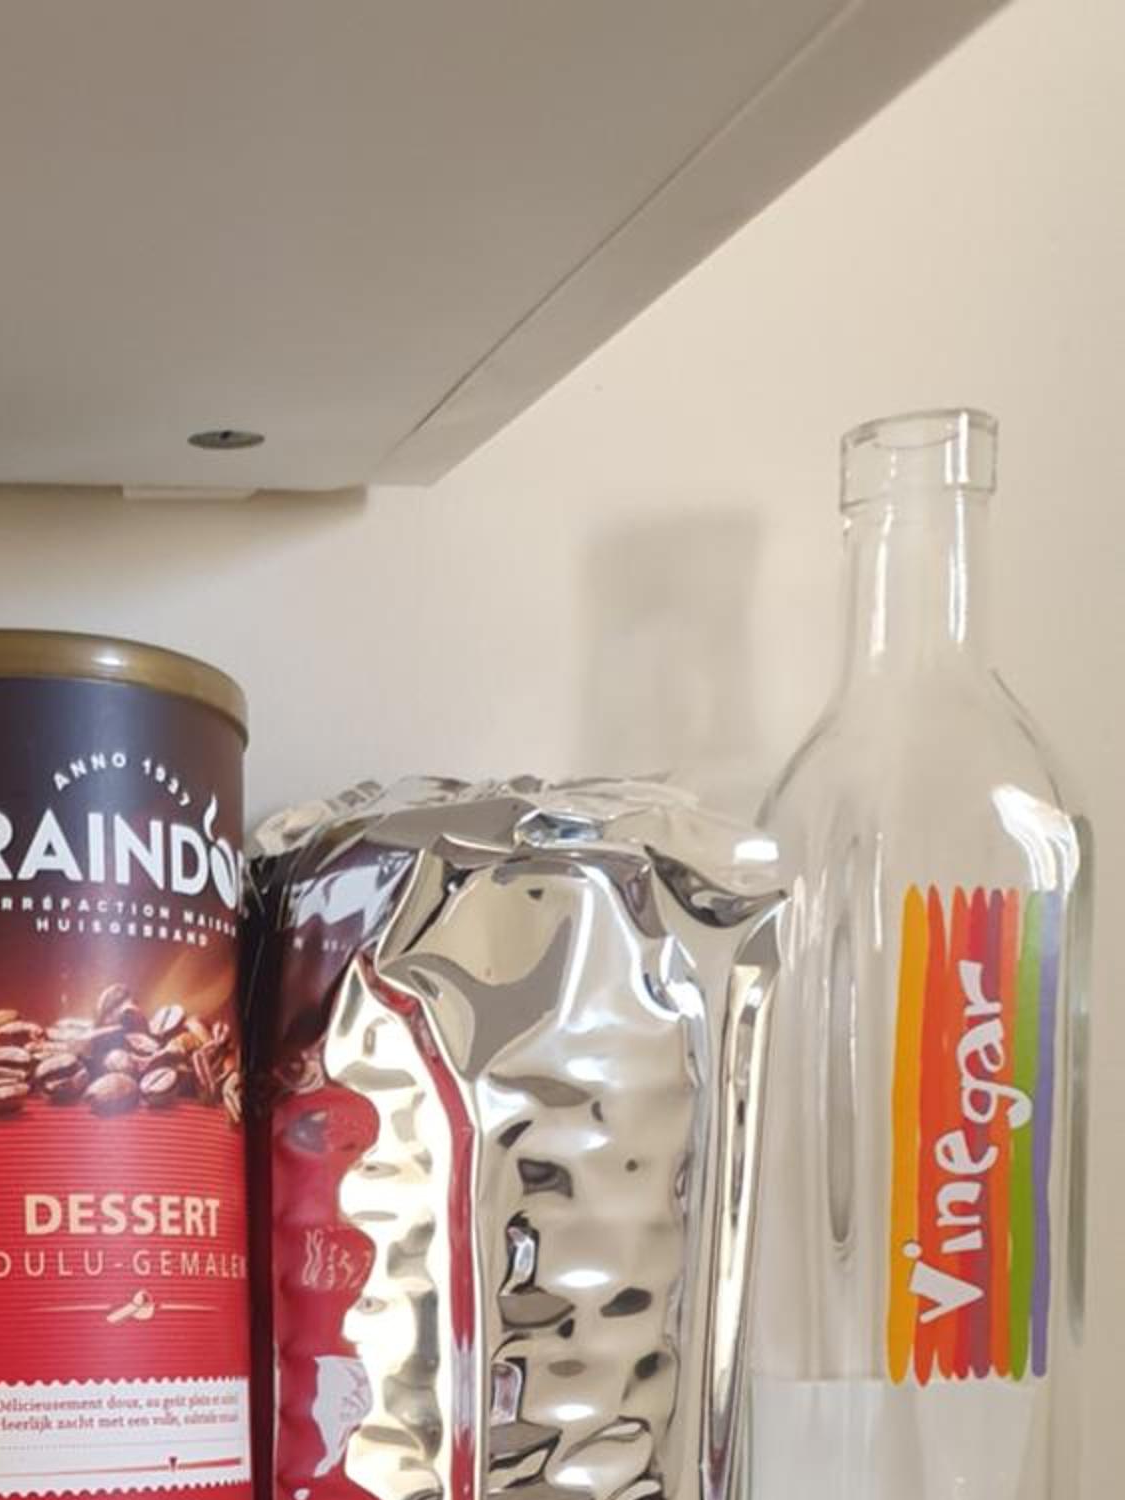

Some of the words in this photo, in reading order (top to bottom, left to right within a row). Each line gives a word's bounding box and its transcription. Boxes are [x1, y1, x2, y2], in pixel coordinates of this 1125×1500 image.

[53, 752, 127, 791] ANNO
[903, 959, 1033, 1323] Vinegar
[25, 1194, 220, 1237] DESSERT
[57, 1413, 94, 1429] zacht
[98, 1415, 125, 1428] met
